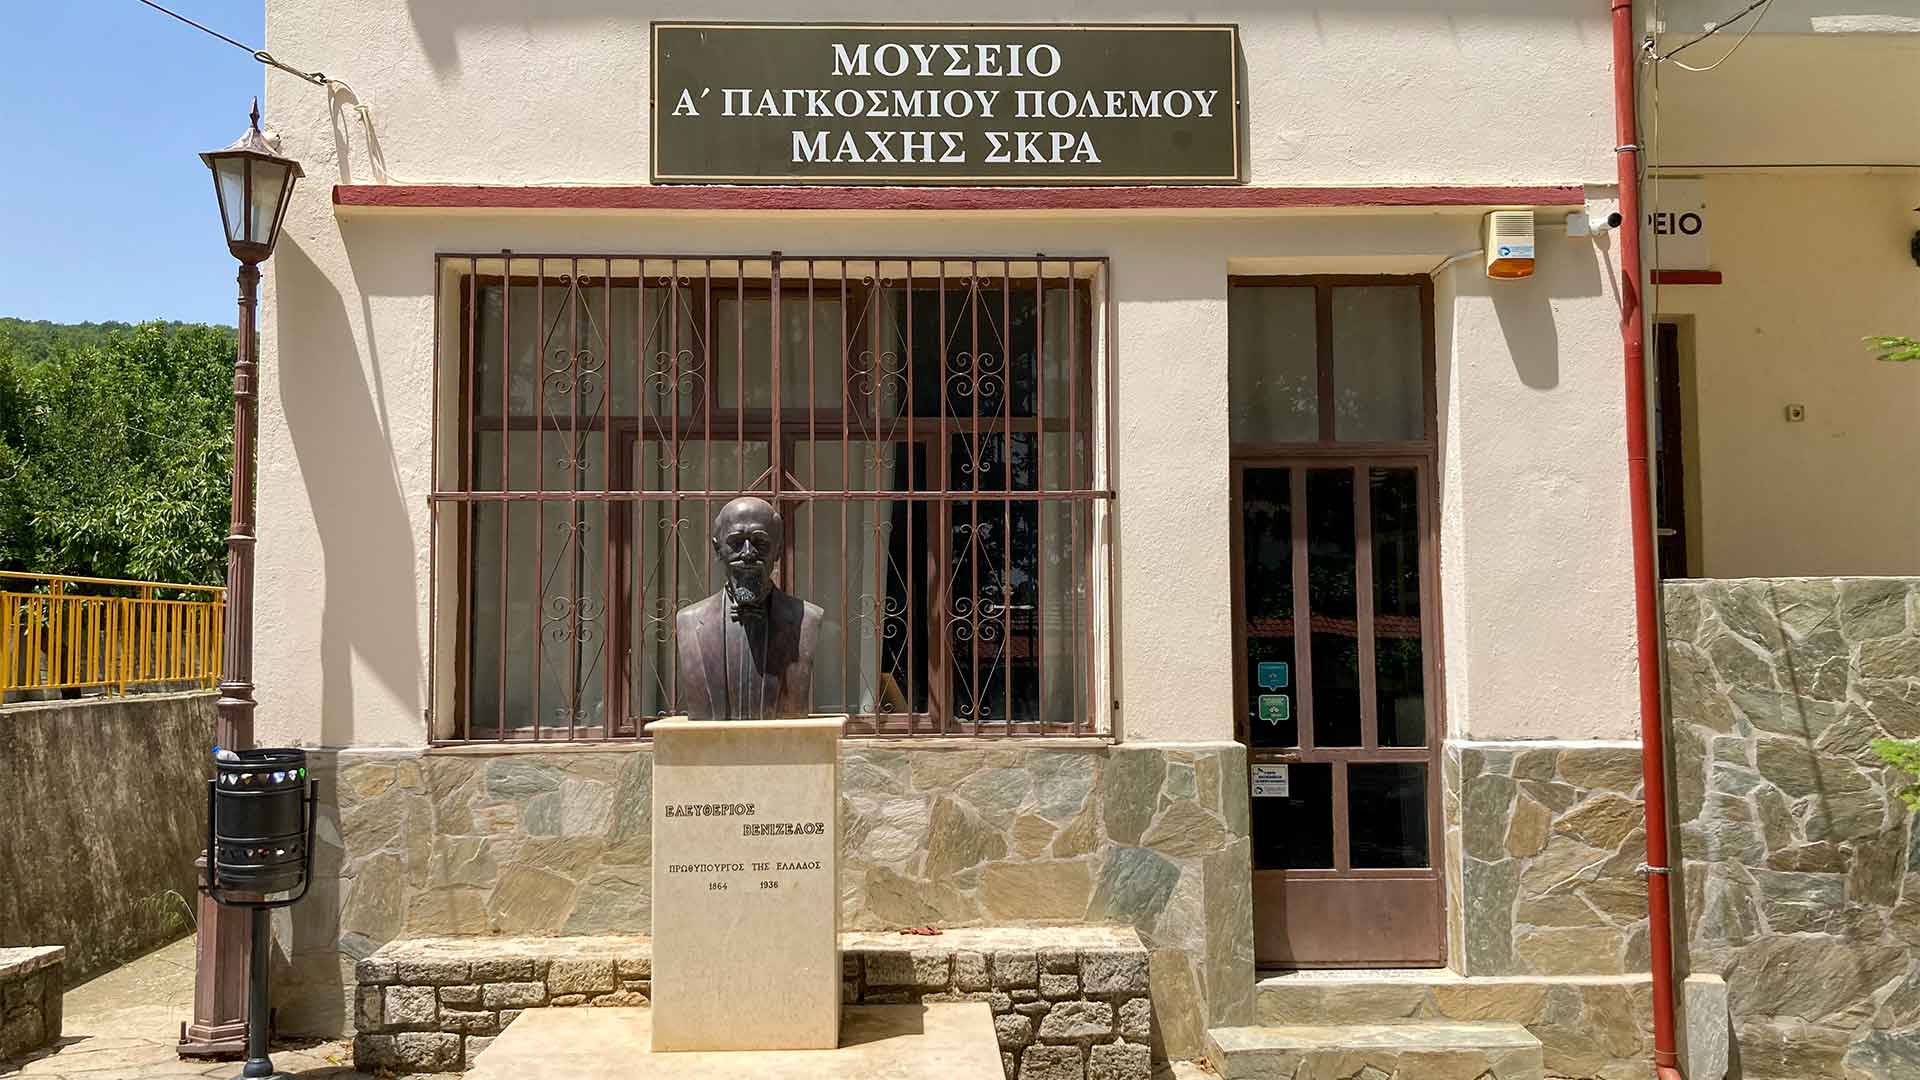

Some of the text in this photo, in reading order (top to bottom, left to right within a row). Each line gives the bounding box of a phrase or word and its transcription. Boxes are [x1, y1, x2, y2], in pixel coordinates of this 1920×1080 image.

[832, 43, 1061, 78] ΜΟΥΣΕΙΟ
[722, 88, 1002, 119] ΠΑΓΚΟΣΜΙΟΥ
[1015, 89, 1218, 119] ΠΟΛΕΜΟΥ
[791, 131, 1101, 164] ΜΑΧΗΣ ΣΚΡΑ
[665, 803, 755, 818] ΕΛΕΥΘΕΡΙΟΣ
[743, 822, 825, 836] ΒΕΝΙΖΕΛΟΣ
[669, 861, 821, 873] ΠΡΩΘΥΠΟΥΡΓΟΣ ΤΗΣ ΕΛΛΑΔΟΣ
[709, 880, 778, 890] 1864 1936
